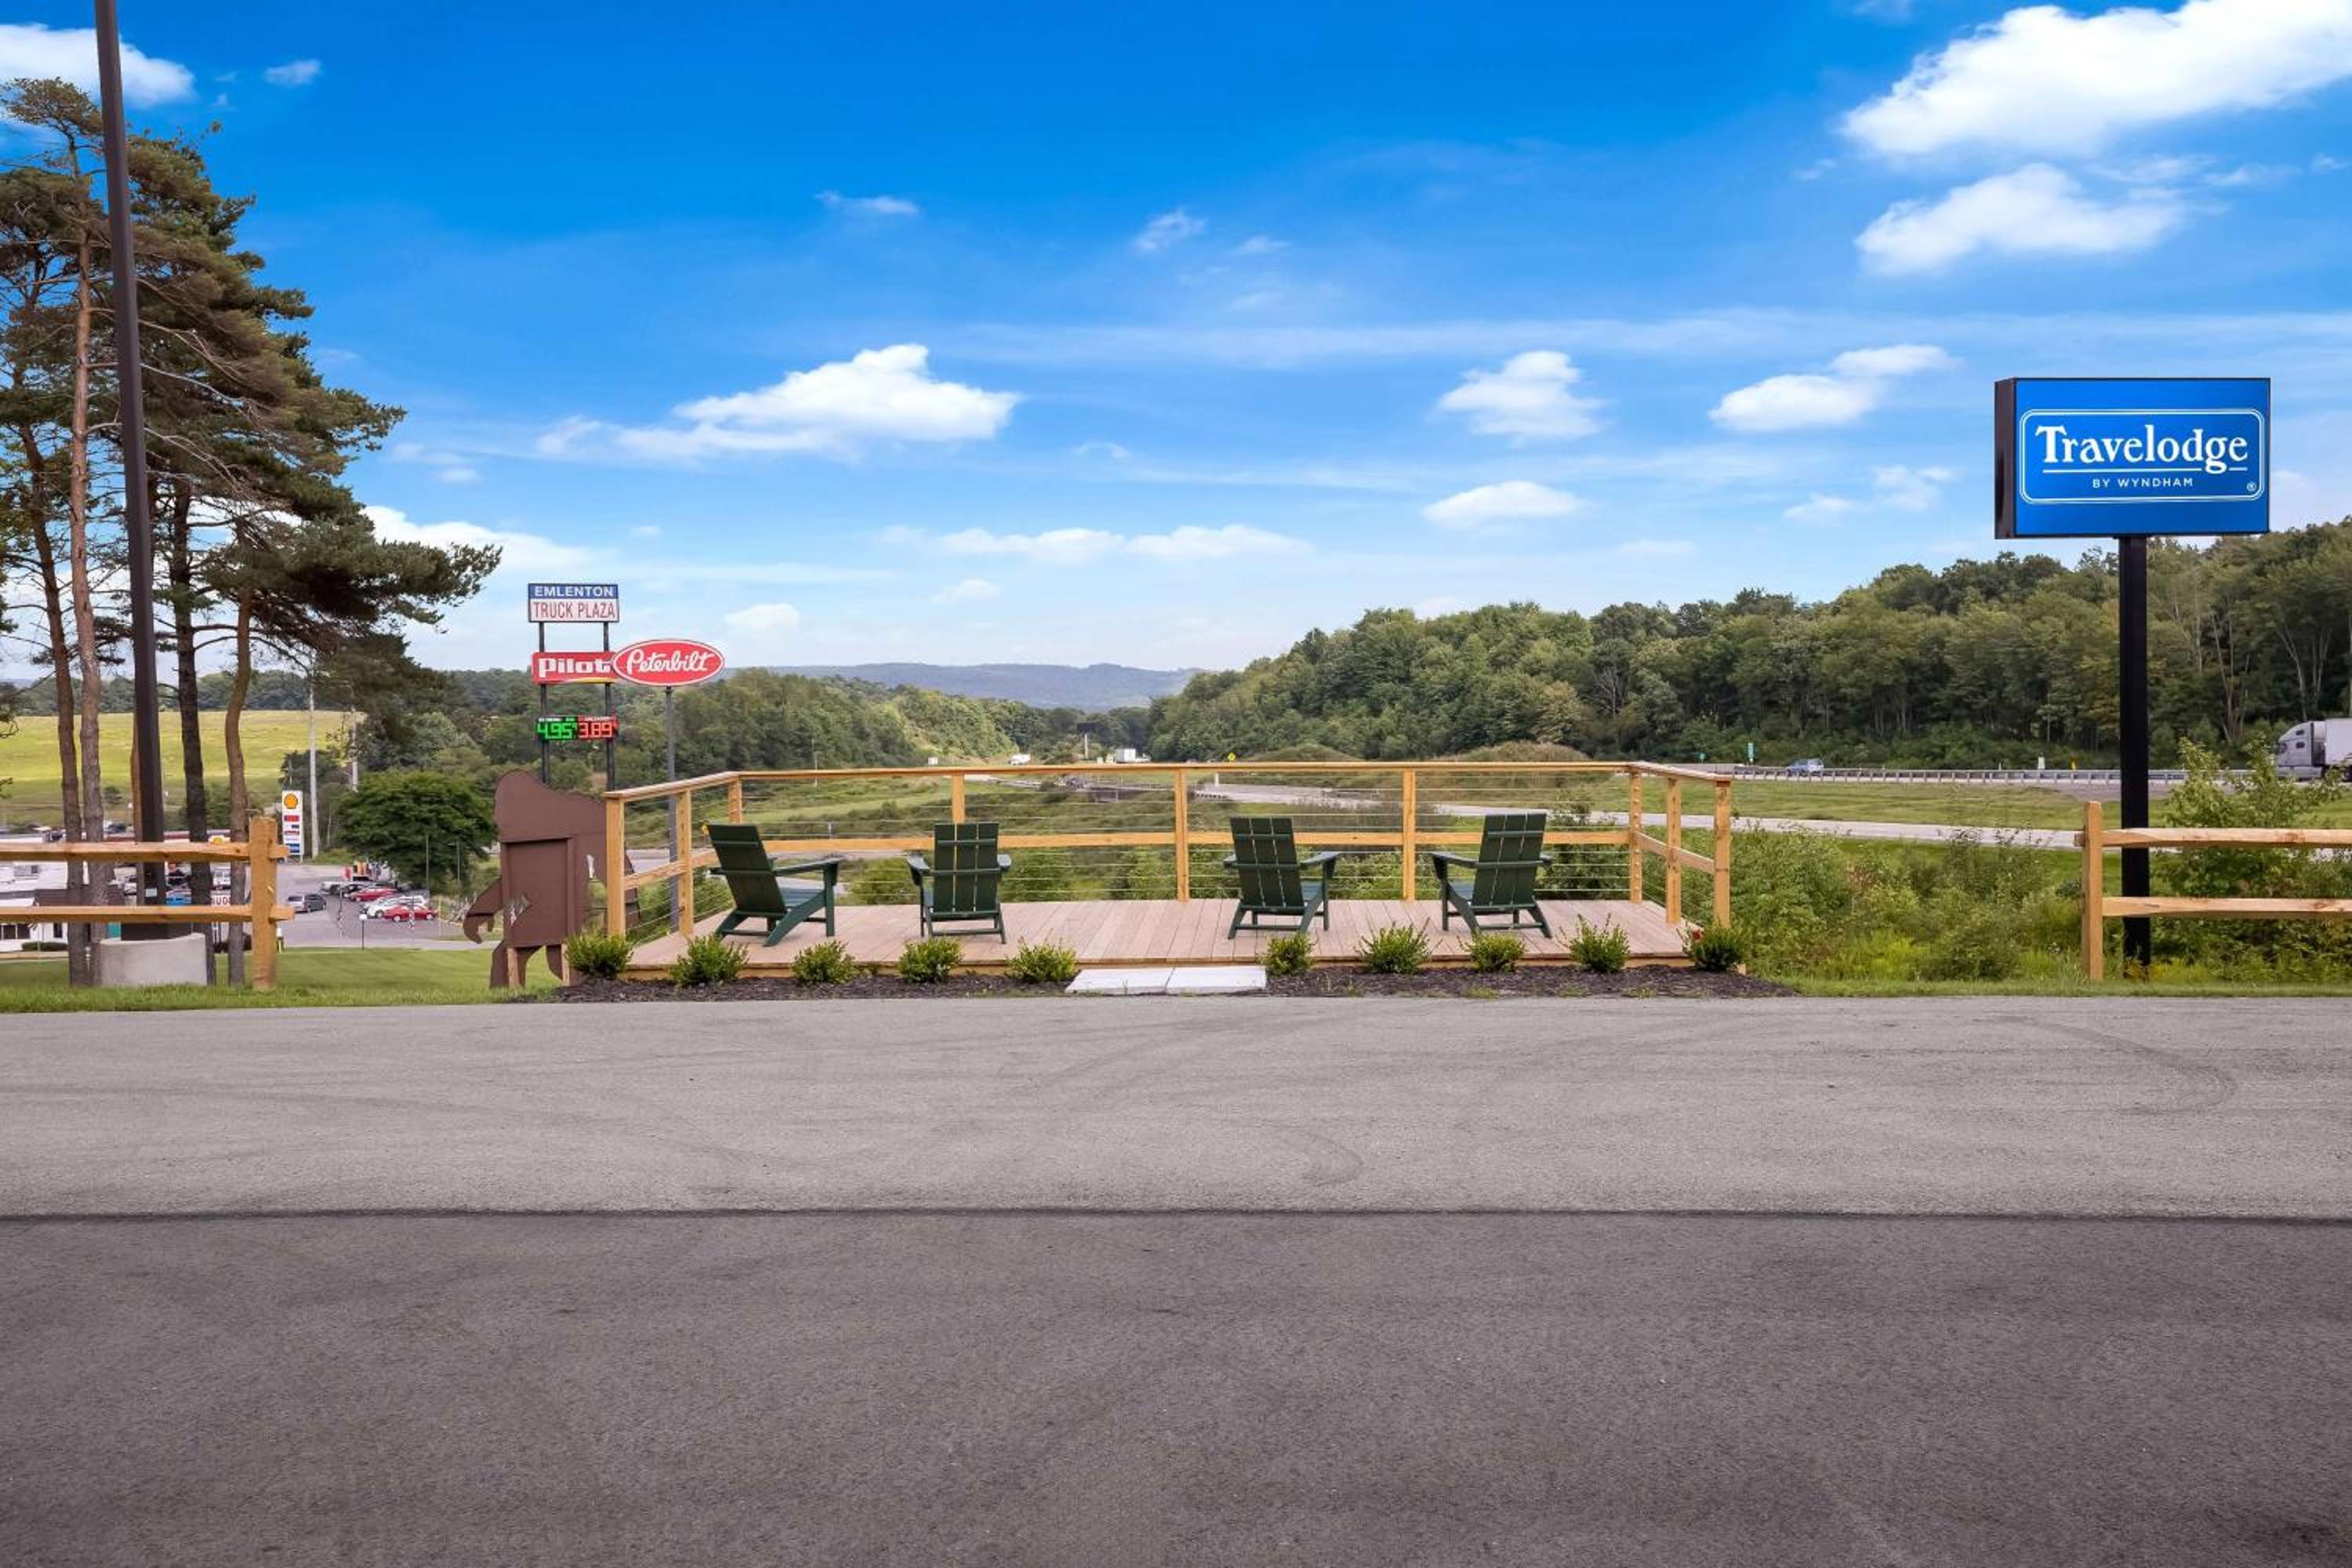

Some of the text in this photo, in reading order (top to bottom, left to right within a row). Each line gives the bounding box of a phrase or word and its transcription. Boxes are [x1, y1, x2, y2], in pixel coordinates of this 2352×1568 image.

[2035, 424, 2248, 474] Travelodge
[2092, 477, 2194, 488] BY WYNDHAM
[535, 586, 613, 596] EMLENTON
[533, 602, 615, 618] TRUCK PLAZA
[539, 658, 611, 677] Pilot
[627, 649, 715, 675] Peterbilt
